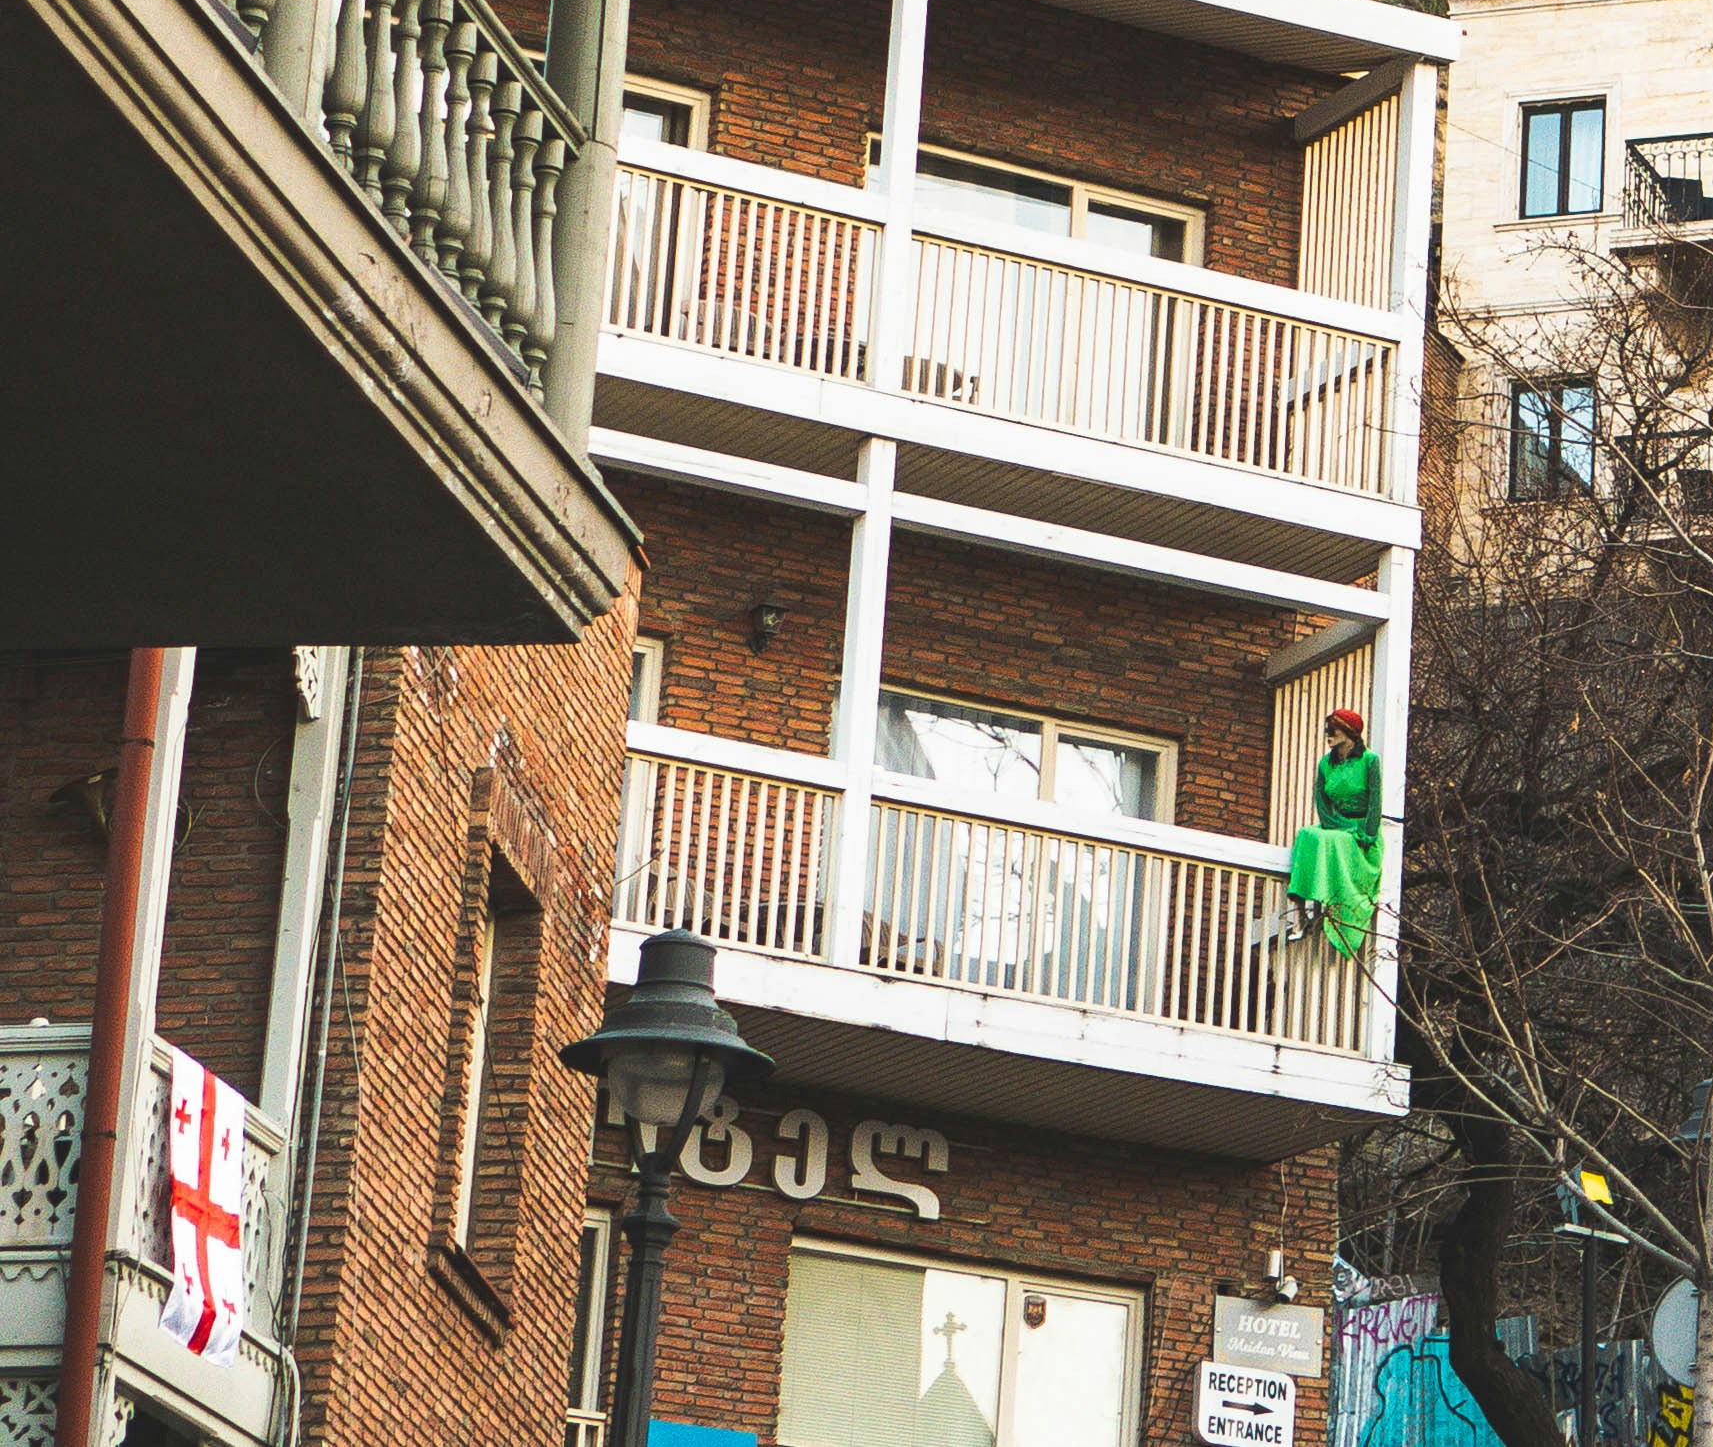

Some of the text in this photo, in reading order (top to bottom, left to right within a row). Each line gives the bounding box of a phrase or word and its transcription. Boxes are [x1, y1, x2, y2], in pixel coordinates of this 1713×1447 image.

[1238, 1315, 1301, 1339] HOTEL
[1209, 1372, 1287, 1401] RECEPTION
[1208, 1415, 1282, 1444] ENTRANCE
